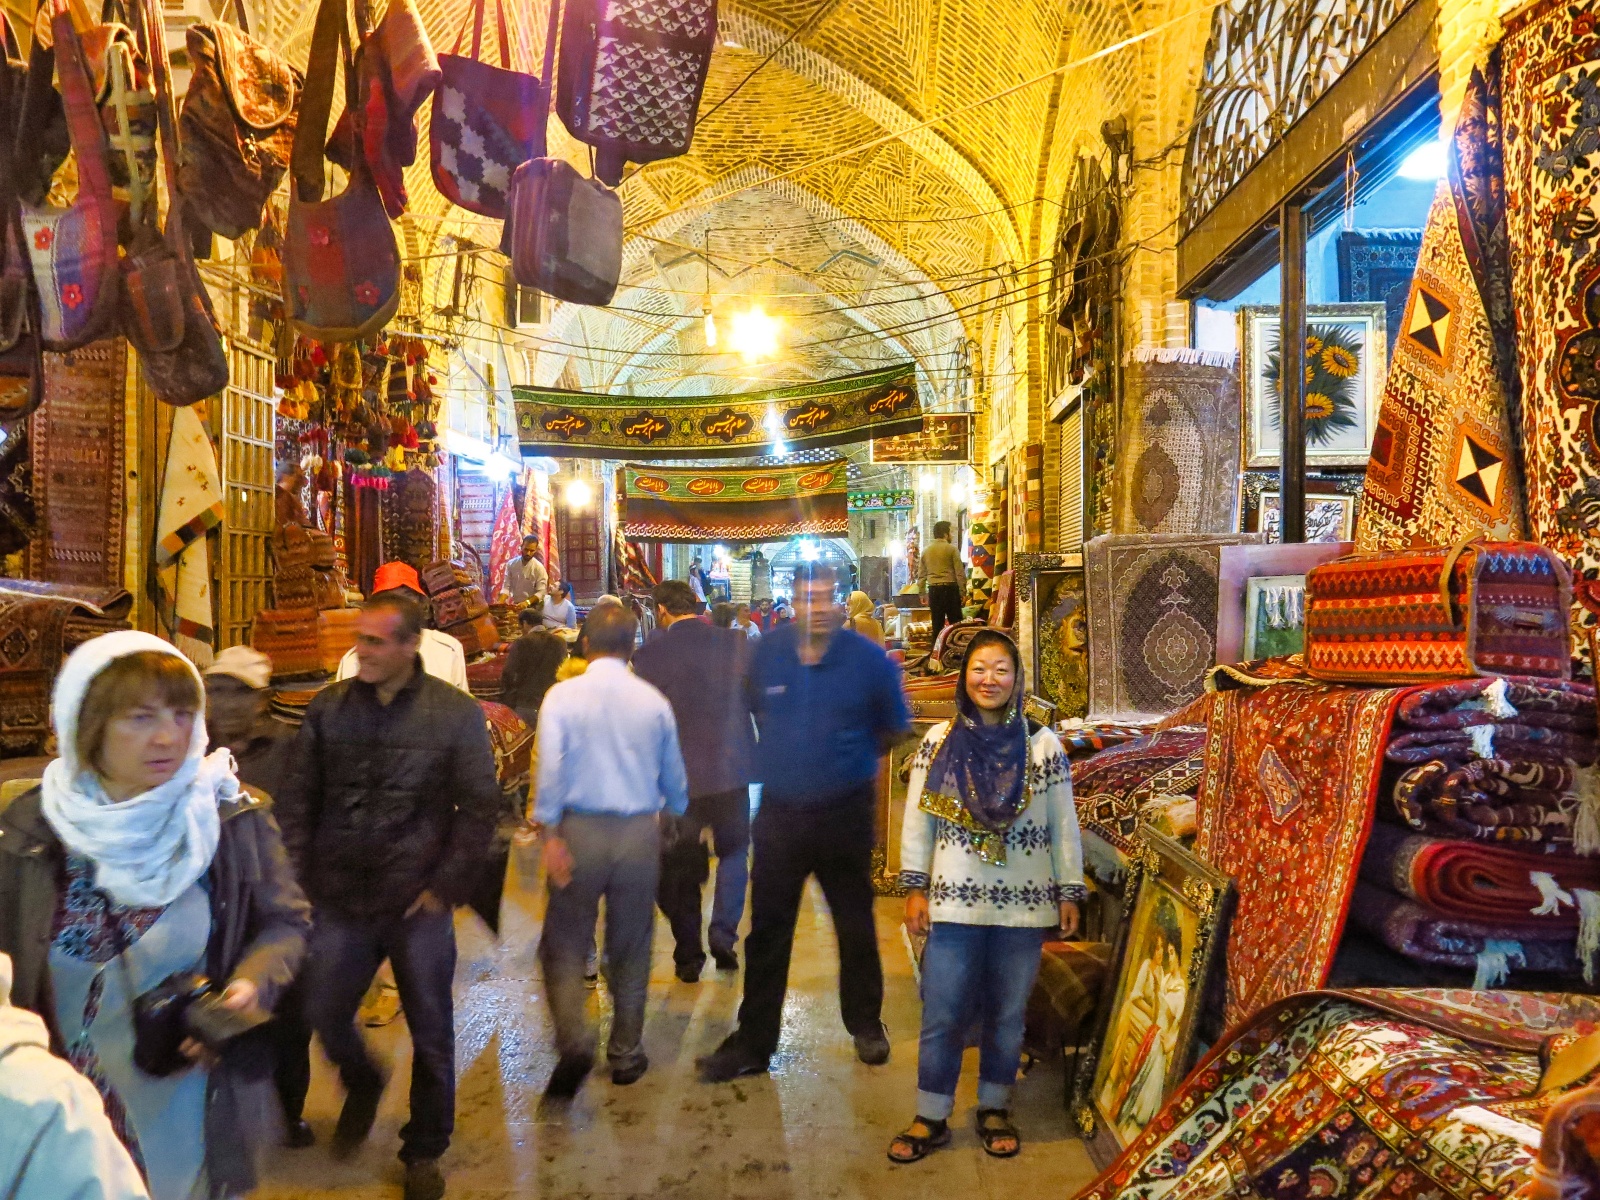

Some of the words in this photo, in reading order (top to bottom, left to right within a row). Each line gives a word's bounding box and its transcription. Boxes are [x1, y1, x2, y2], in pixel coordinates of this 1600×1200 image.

[870, 389, 897, 411] حسین
[891, 392, 908, 411] سلام
[546, 415, 574, 430] حسین
[707, 415, 733, 434] حسین
[789, 407, 818, 426] حسین
[812, 410, 829, 428] سلام
[567, 421, 586, 436] سلام
[626, 418, 654, 434] حسین
[648, 423, 664, 439] سلام
[730, 420, 747, 437] سلام
[925, 421, 947, 433] فرش
